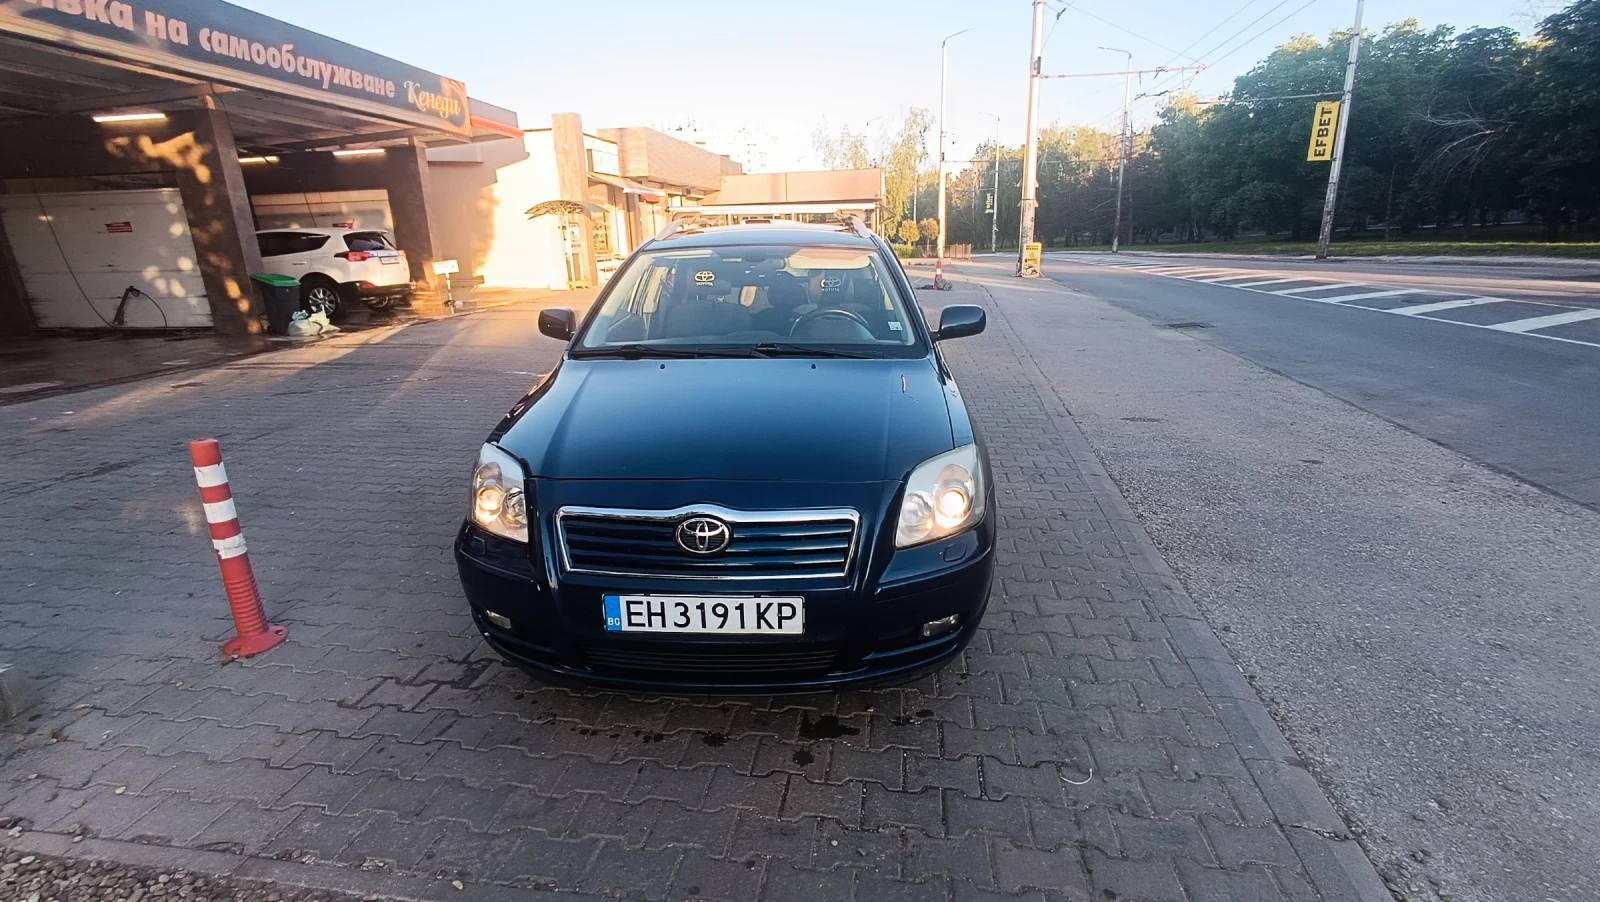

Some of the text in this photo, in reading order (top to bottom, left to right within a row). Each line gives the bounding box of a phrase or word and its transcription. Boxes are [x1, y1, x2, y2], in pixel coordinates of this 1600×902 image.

[24, 0, 396, 99] вка на самообслужване
[403, 80, 461, 118] Кенеди
[1313, 106, 1333, 157] EFBET
[607, 617, 621, 626] BG
